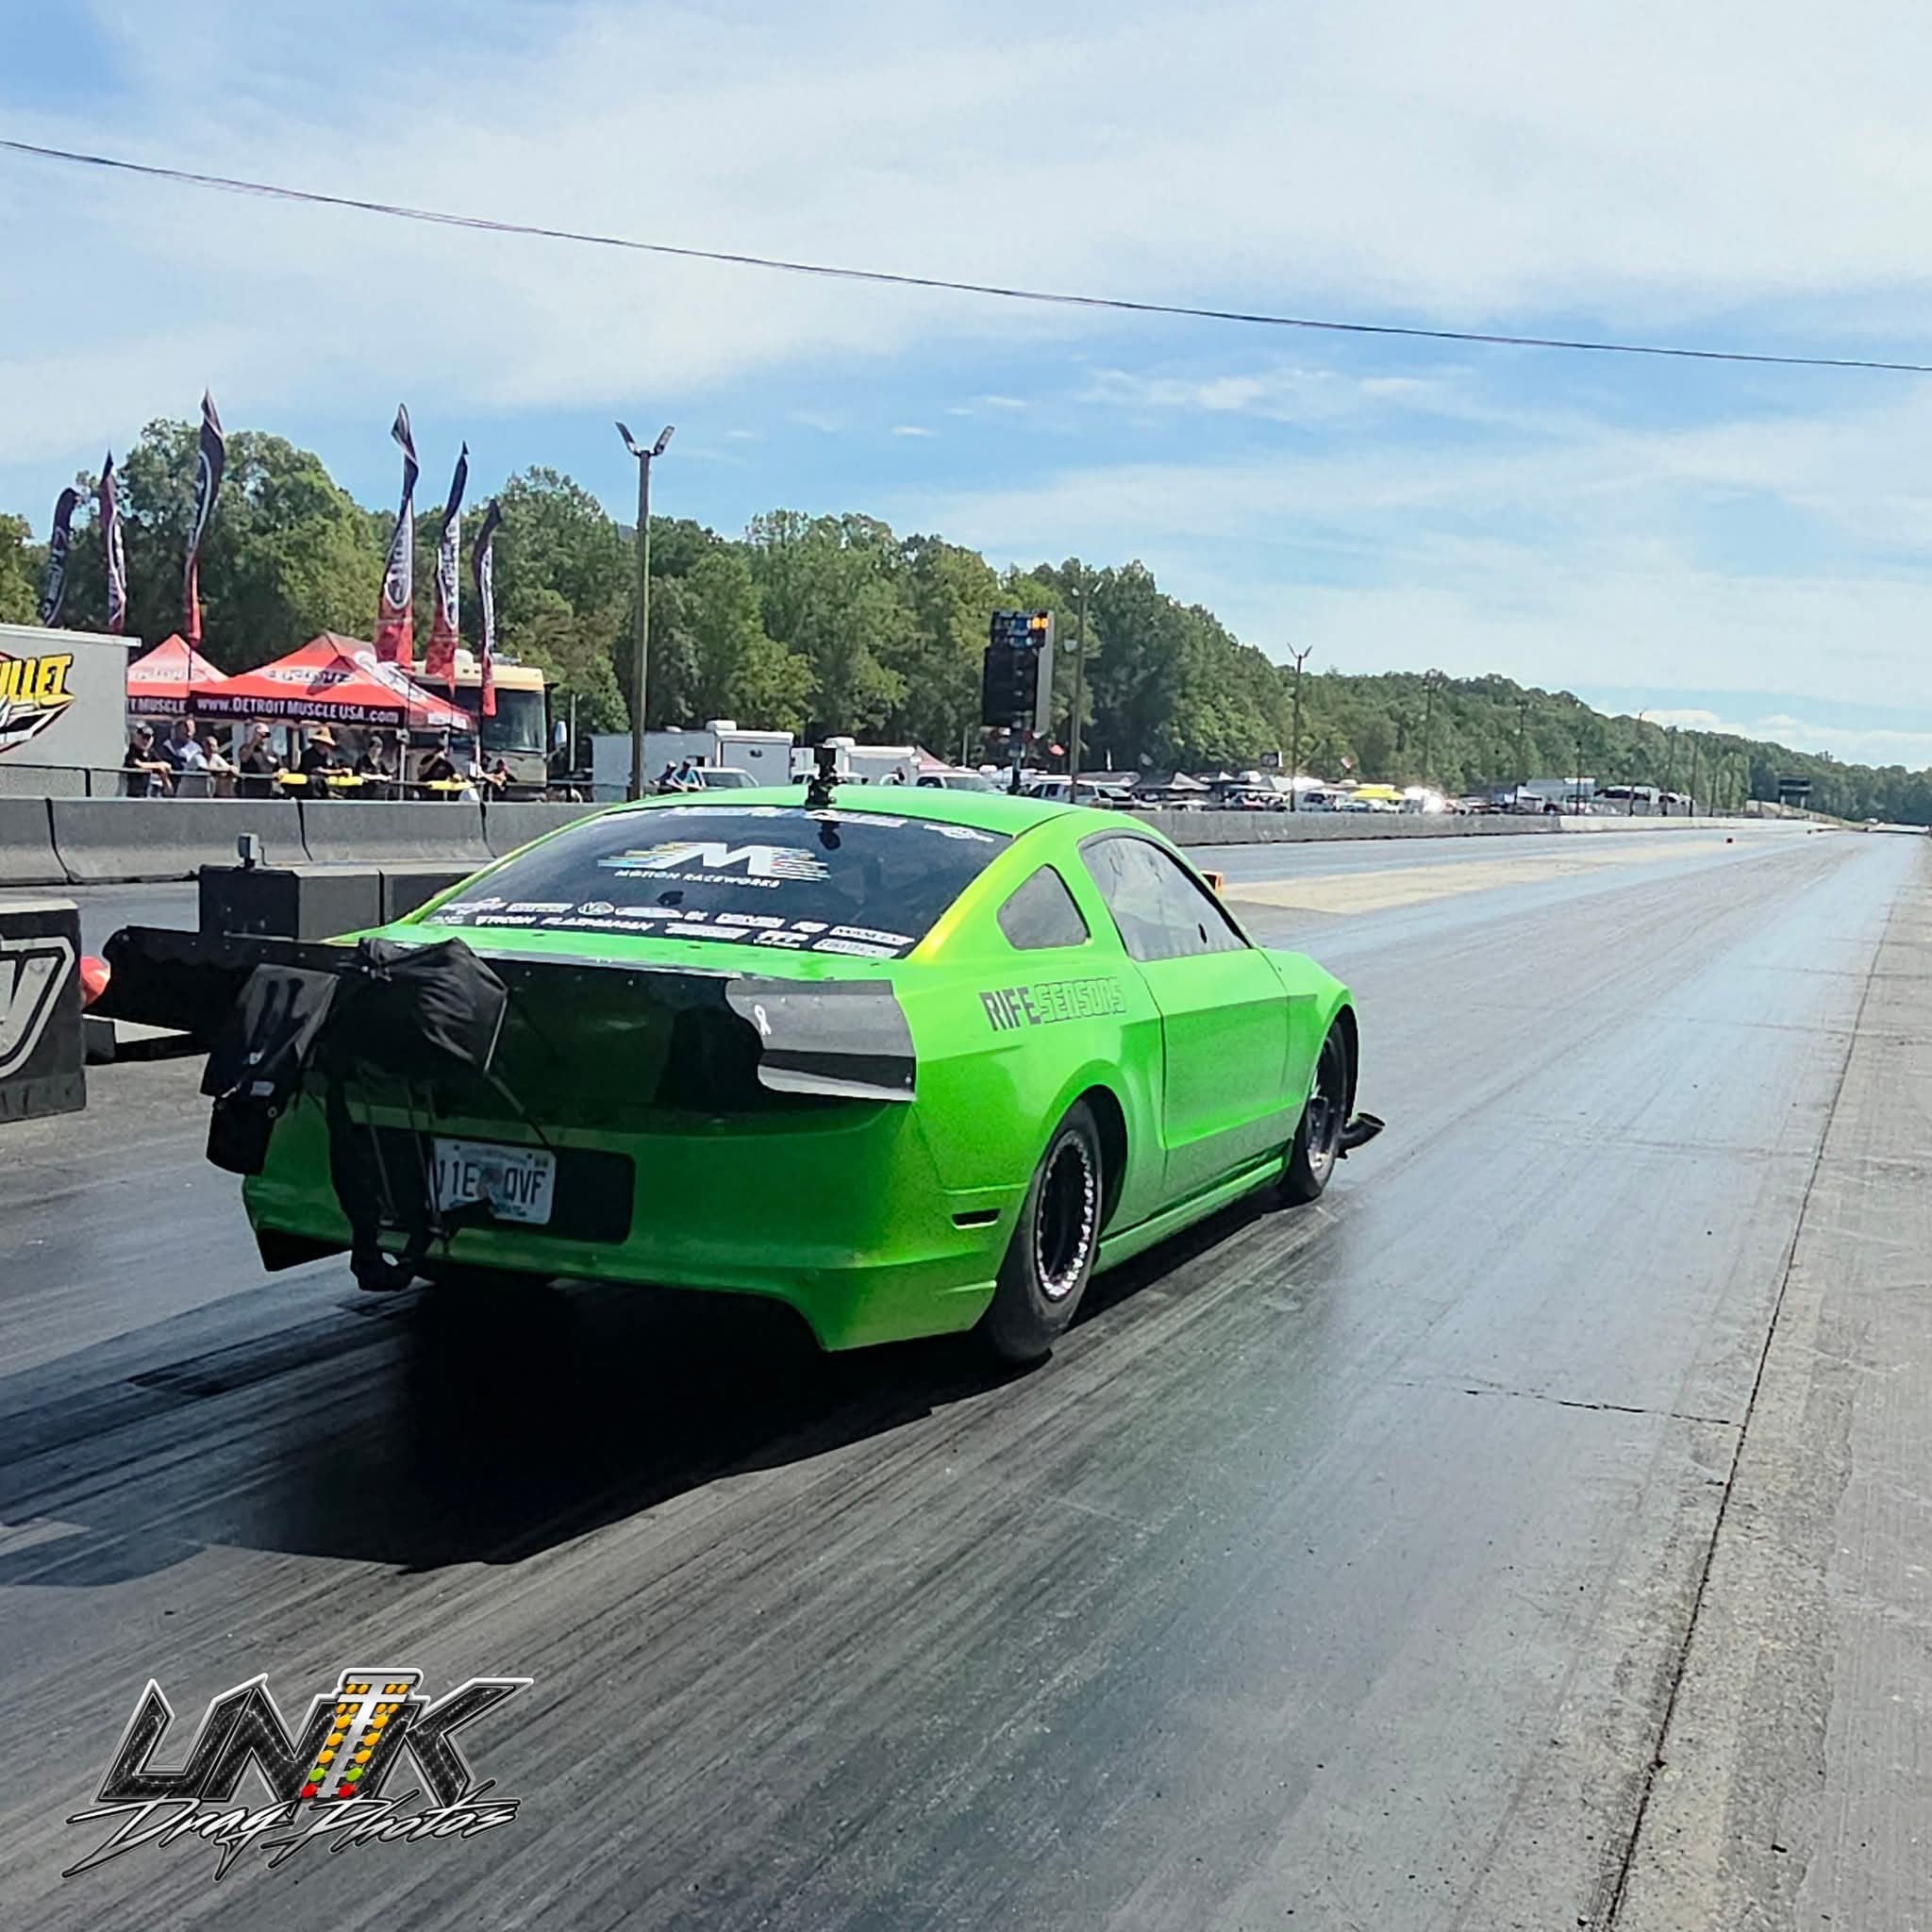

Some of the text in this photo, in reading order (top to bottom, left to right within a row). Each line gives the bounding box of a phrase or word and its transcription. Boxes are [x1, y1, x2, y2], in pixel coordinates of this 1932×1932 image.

[614, 869, 781, 889] MOTION RACEWORKS
[978, 986, 1041, 1032] RIFE
